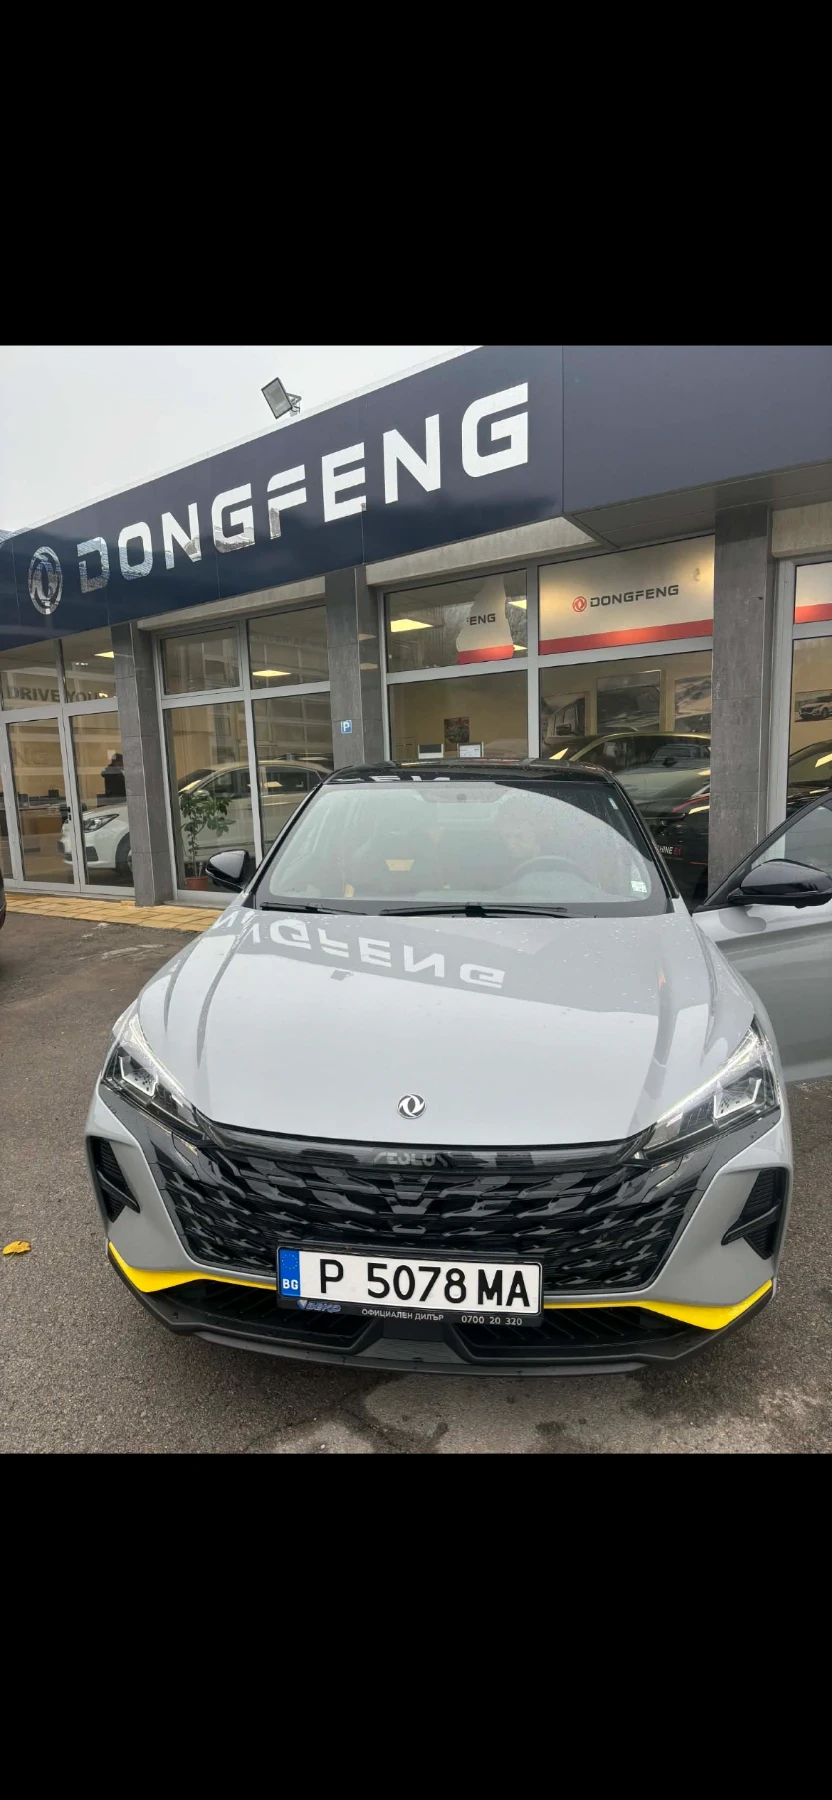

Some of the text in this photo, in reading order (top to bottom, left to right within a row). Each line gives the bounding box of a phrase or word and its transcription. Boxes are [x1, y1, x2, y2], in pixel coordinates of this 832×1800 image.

[77, 382, 528, 594] DONGFENG
[590, 585, 679, 607] DONGFENG
[7, 686, 60, 703] DRIVE
[343, 721, 350, 732] P
[372, 1151, 449, 1168] AEOLUS
[282, 1278, 299, 1291] BG
[319, 1258, 531, 1308] P 5078 MA
[361, 1308, 523, 1326] ОФИЦИАЛЕН ДИЛЪР 0700 20 320
